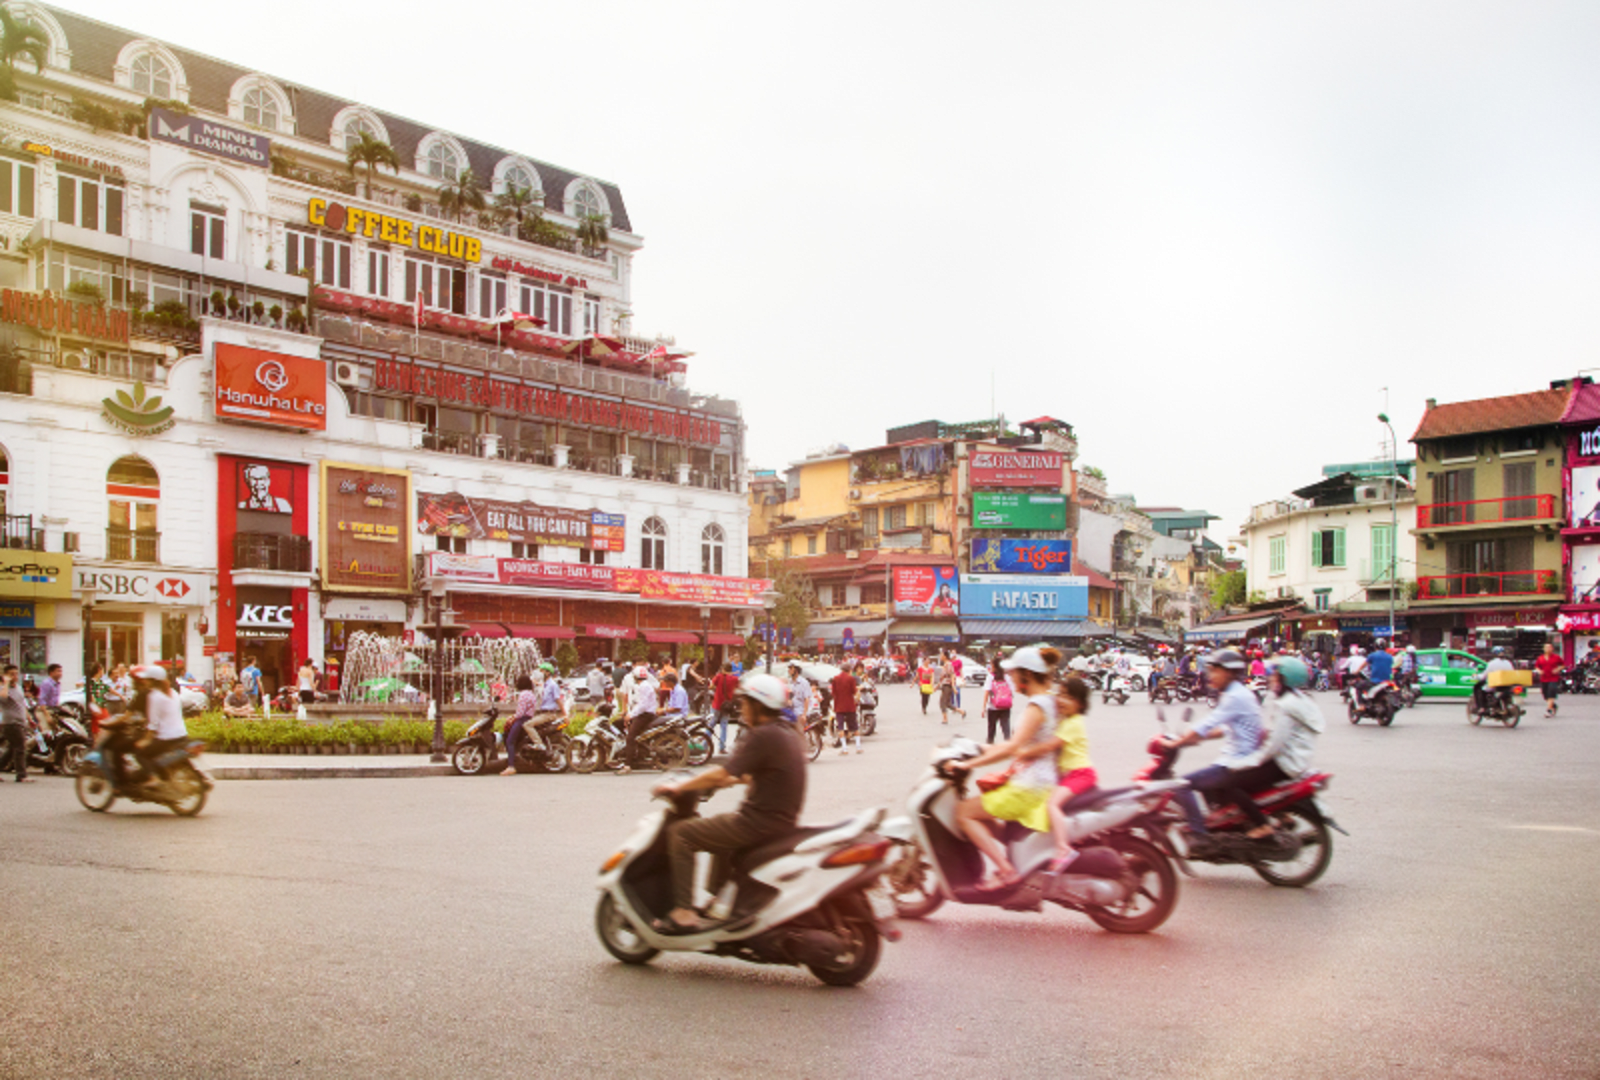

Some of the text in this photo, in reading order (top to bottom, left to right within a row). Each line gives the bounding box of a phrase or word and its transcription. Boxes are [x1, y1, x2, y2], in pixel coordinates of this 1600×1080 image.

[194, 134, 264, 160] DIAMOND
[203, 123, 256, 147] MINH
[418, 225, 482, 263] CLUB
[217, 386, 291, 410] Hanwha
[293, 398, 325, 415] Life
[993, 455, 1061, 469] GENERALI
[487, 511, 505, 529] EAT
[1014, 545, 1068, 570] Tiger
[78, 571, 149, 597] HSBC
[0, 607, 32, 618] ERA
[239, 603, 294, 623] KFC
